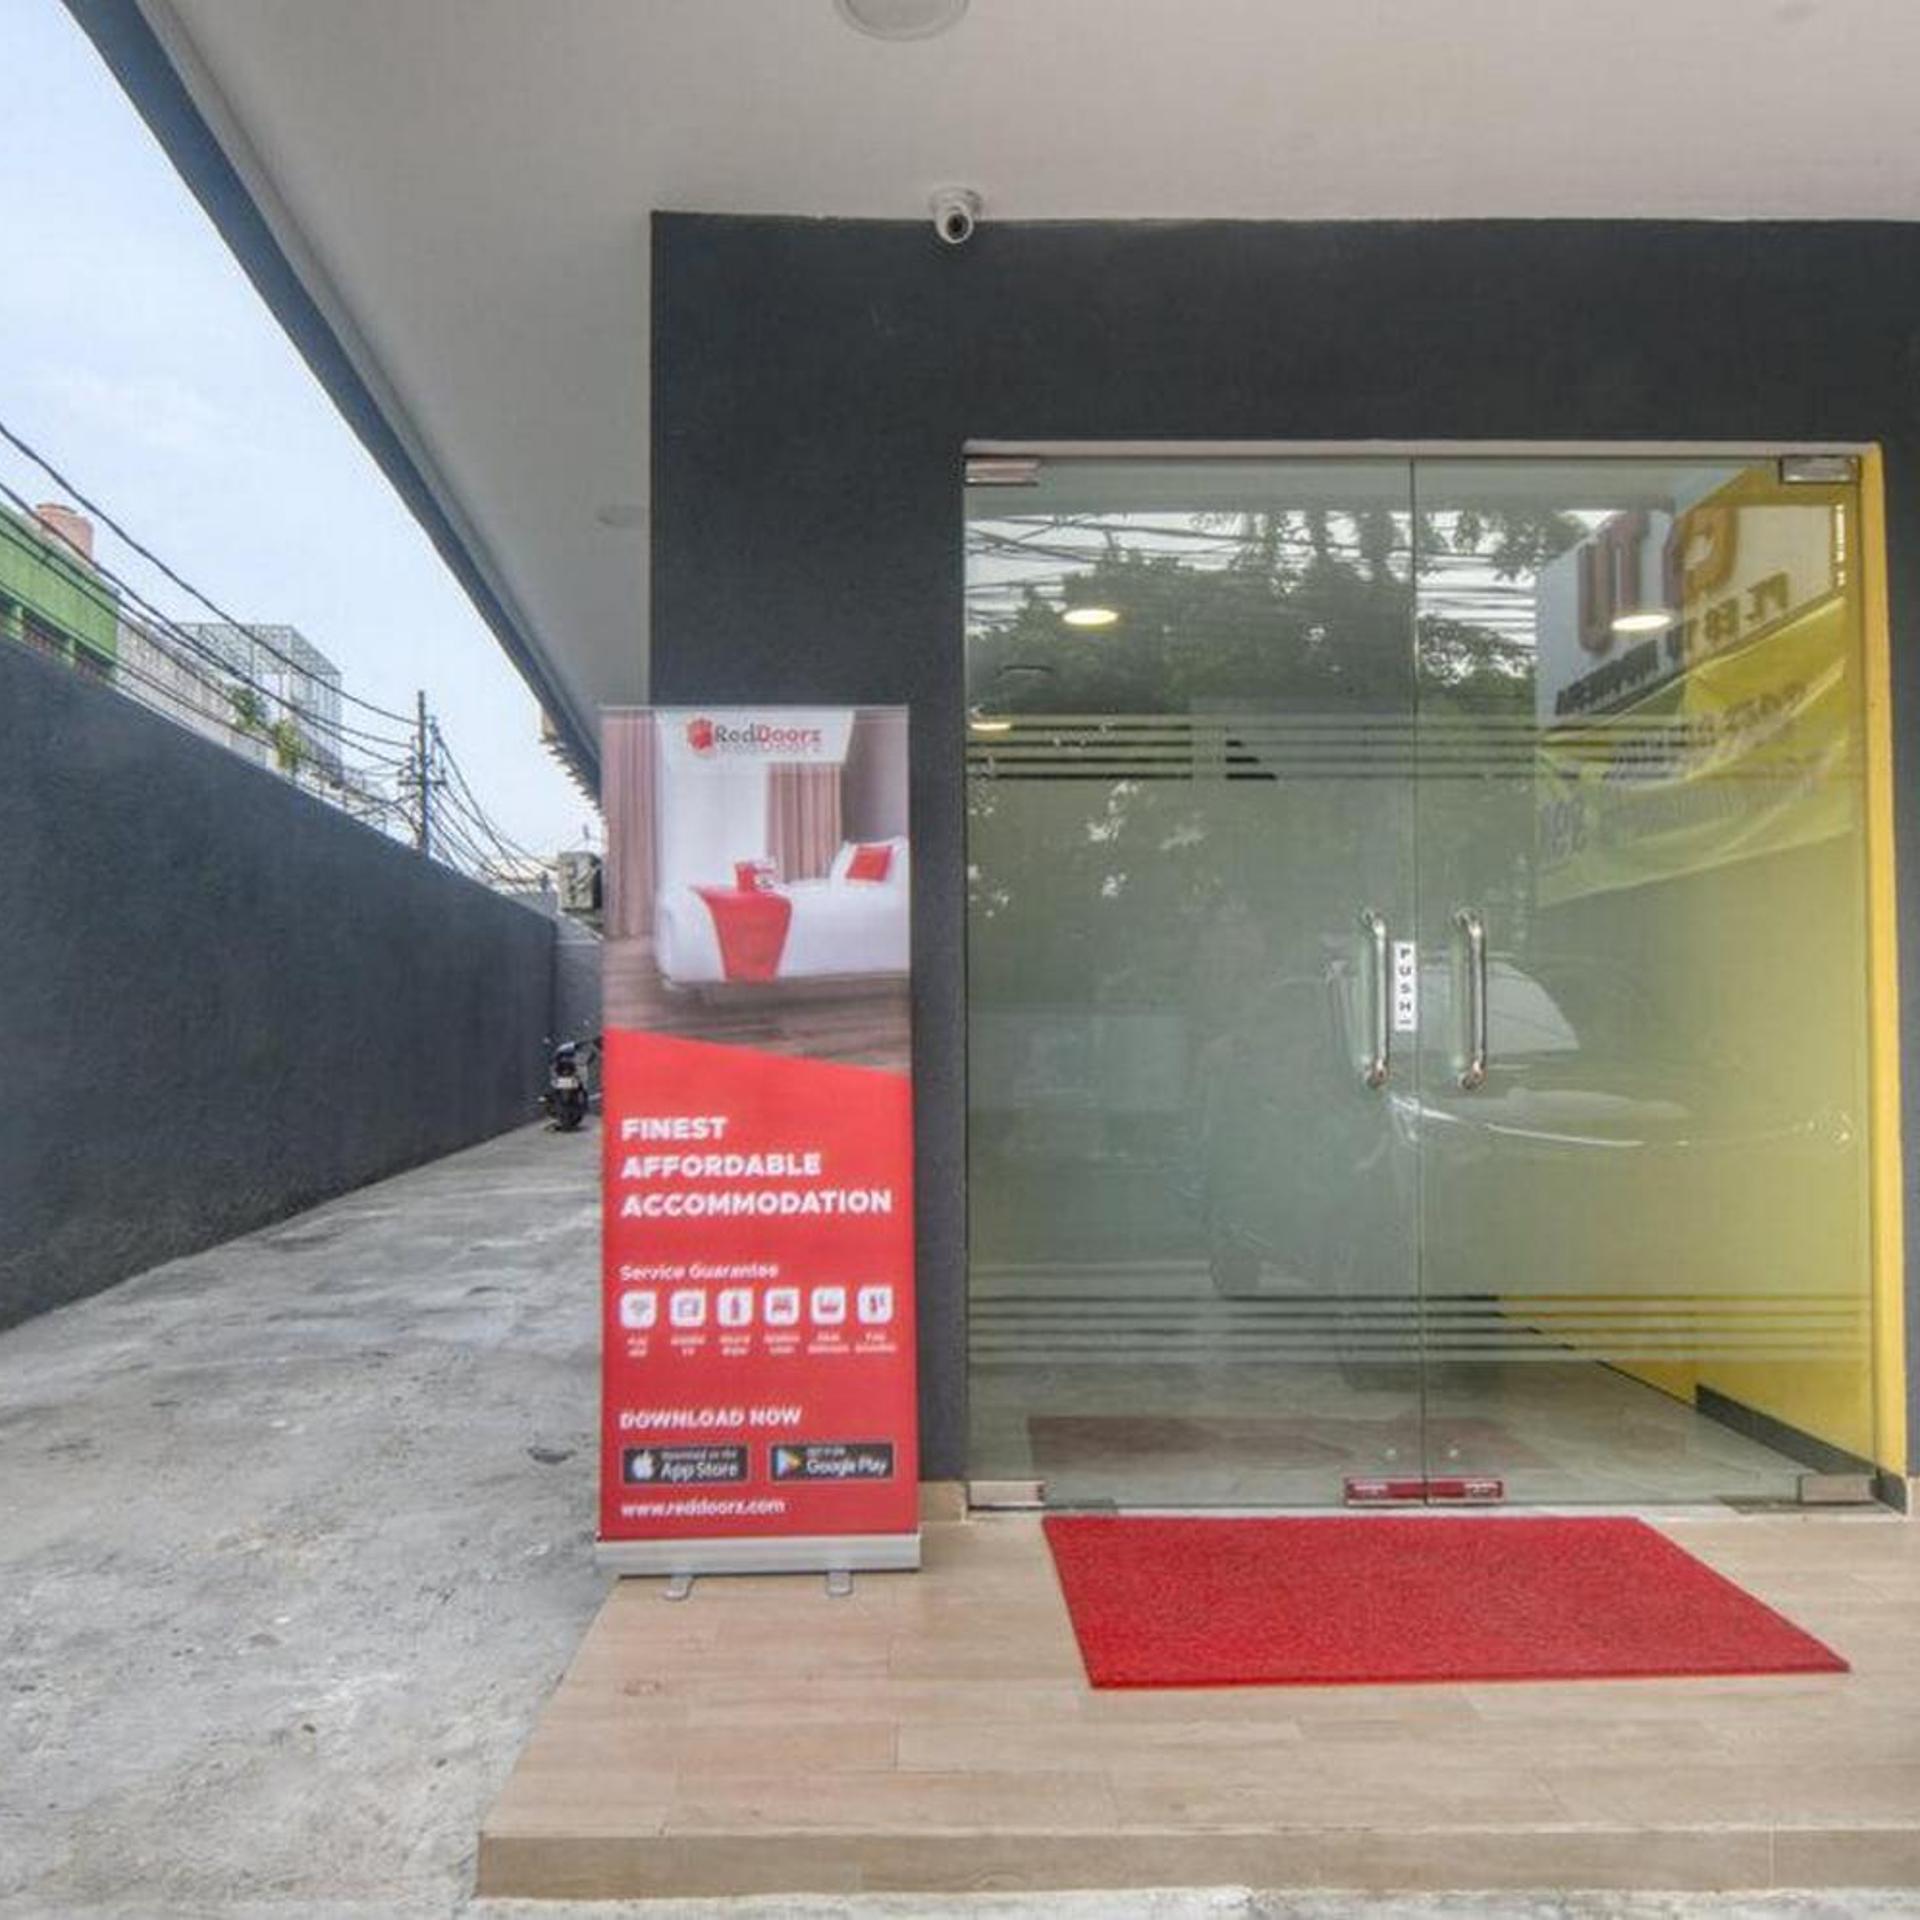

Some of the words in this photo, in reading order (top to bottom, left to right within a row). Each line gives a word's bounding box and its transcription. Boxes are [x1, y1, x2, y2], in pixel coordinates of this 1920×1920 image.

[714, 723, 821, 743] RedDoorz
[621, 1116, 727, 1140] FINEST
[621, 1153, 821, 1178] AFFORDABLE
[621, 1190, 892, 1217] ACCOMMODATION
[619, 1264, 685, 1281] Service
[688, 1263, 779, 1279] Guarantee
[619, 1410, 745, 1430] DOWNLOAD
[749, 1408, 801, 1426] NOW
[661, 1462, 695, 1482] App
[697, 1461, 738, 1478] Store
[807, 1459, 856, 1476] Google
[859, 1456, 887, 1475] Play
[621, 1498, 785, 1517] www.reddoorz.com
